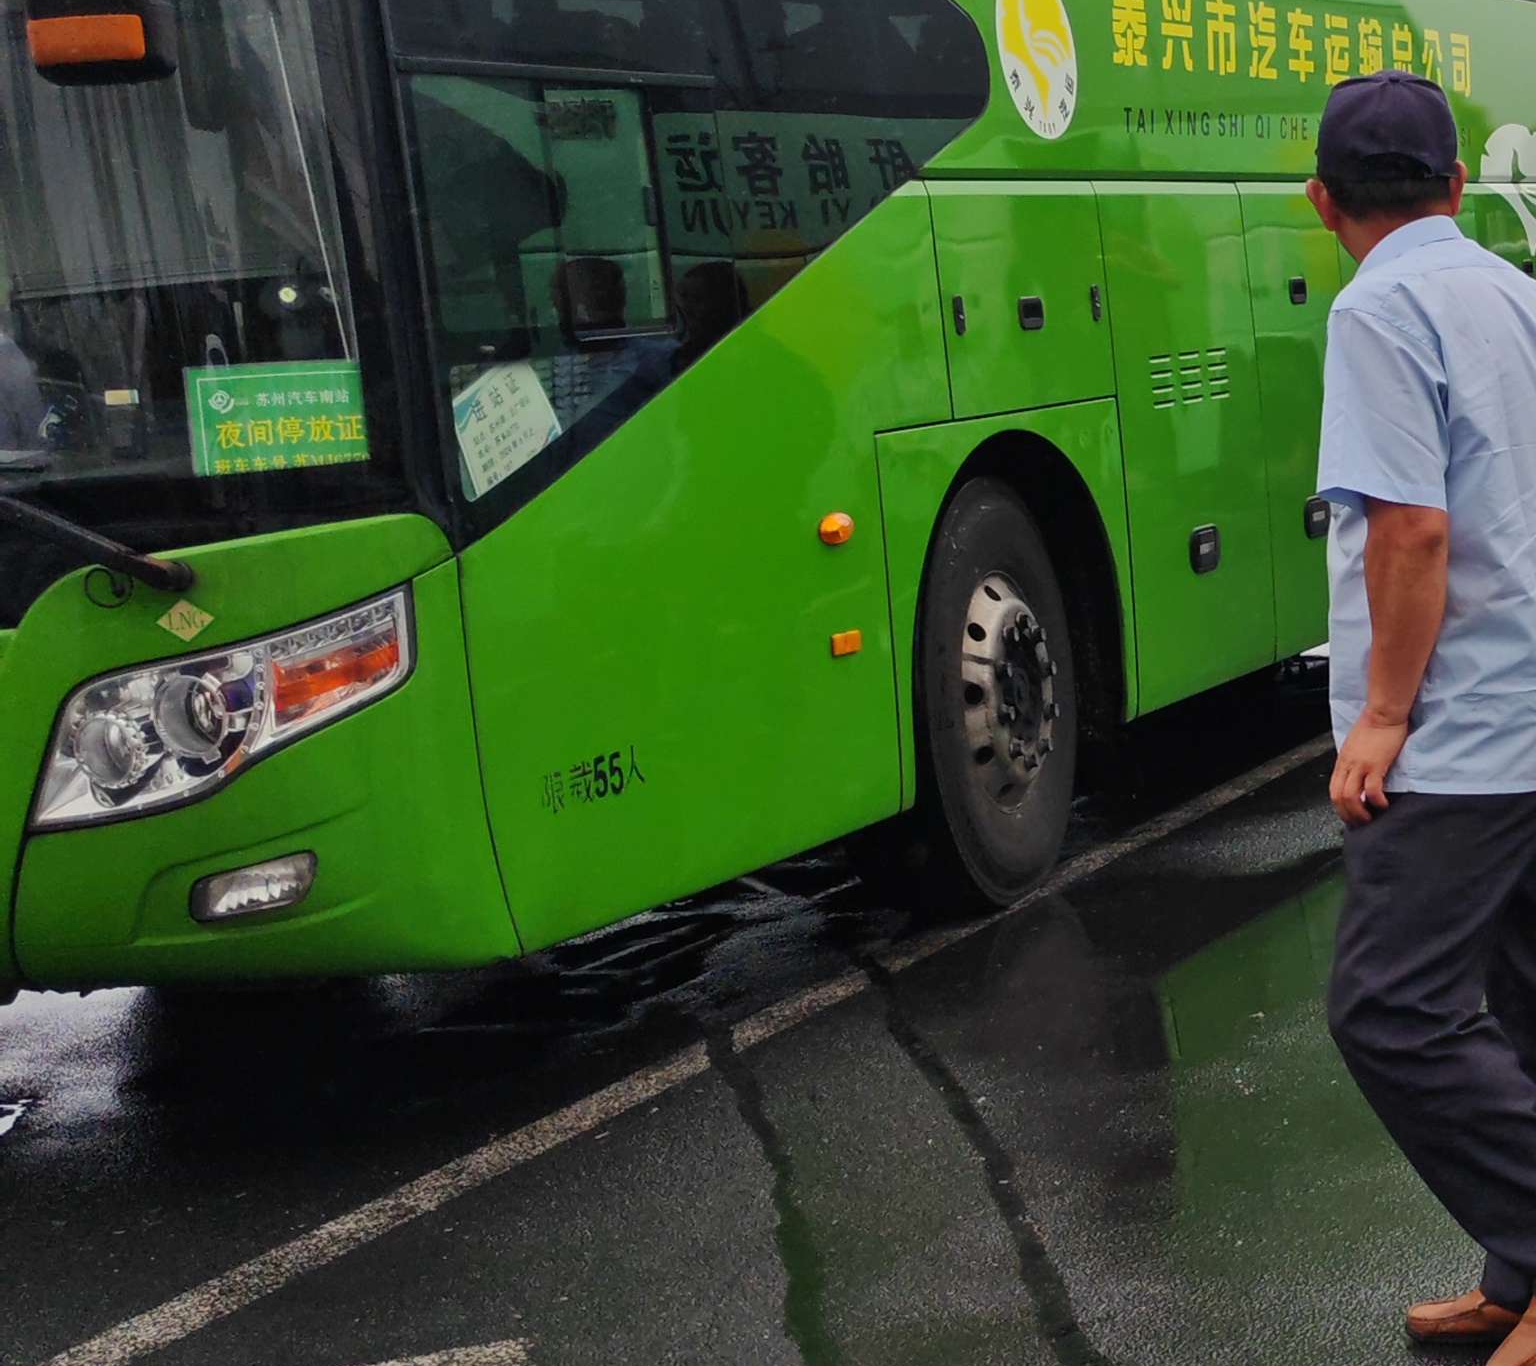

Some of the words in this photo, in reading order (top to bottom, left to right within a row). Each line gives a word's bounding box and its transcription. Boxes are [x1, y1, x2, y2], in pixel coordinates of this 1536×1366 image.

[1123, 107, 1155, 134] TAI
[1165, 109, 1210, 137] XING
[1218, 112, 1245, 138] SHI
[1255, 114, 1271, 139] QI
[1280, 116, 1308, 141] CHE
[255, 388, 350, 407] 苏州汽车南站
[215, 413, 366, 450] 夜间停放证
[168, 610, 205, 631] LNG
